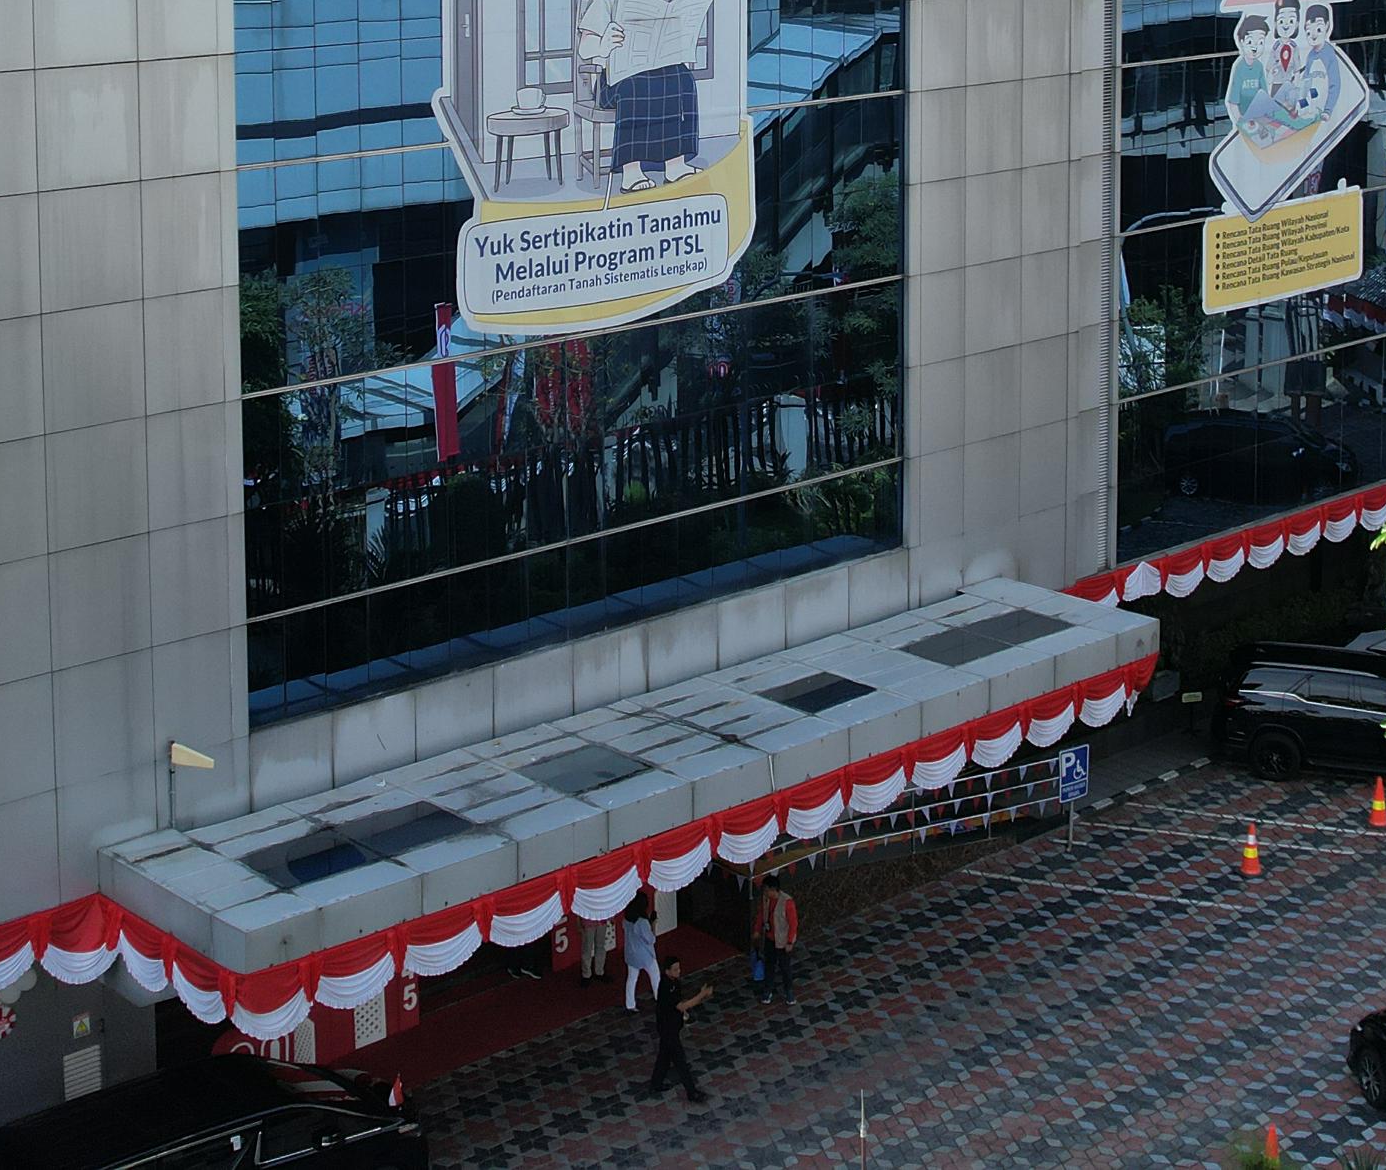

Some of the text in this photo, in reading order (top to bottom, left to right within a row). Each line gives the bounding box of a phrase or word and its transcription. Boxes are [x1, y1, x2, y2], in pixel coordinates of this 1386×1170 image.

[474, 206, 722, 258] Yuk Sertipikatin Tanahmu
[491, 257, 709, 305] (Pendaftaran Tanah Sistematis Lengkap)
[495, 233, 705, 284] Melalui Program PTSL
[1061, 752, 1076, 778] P
